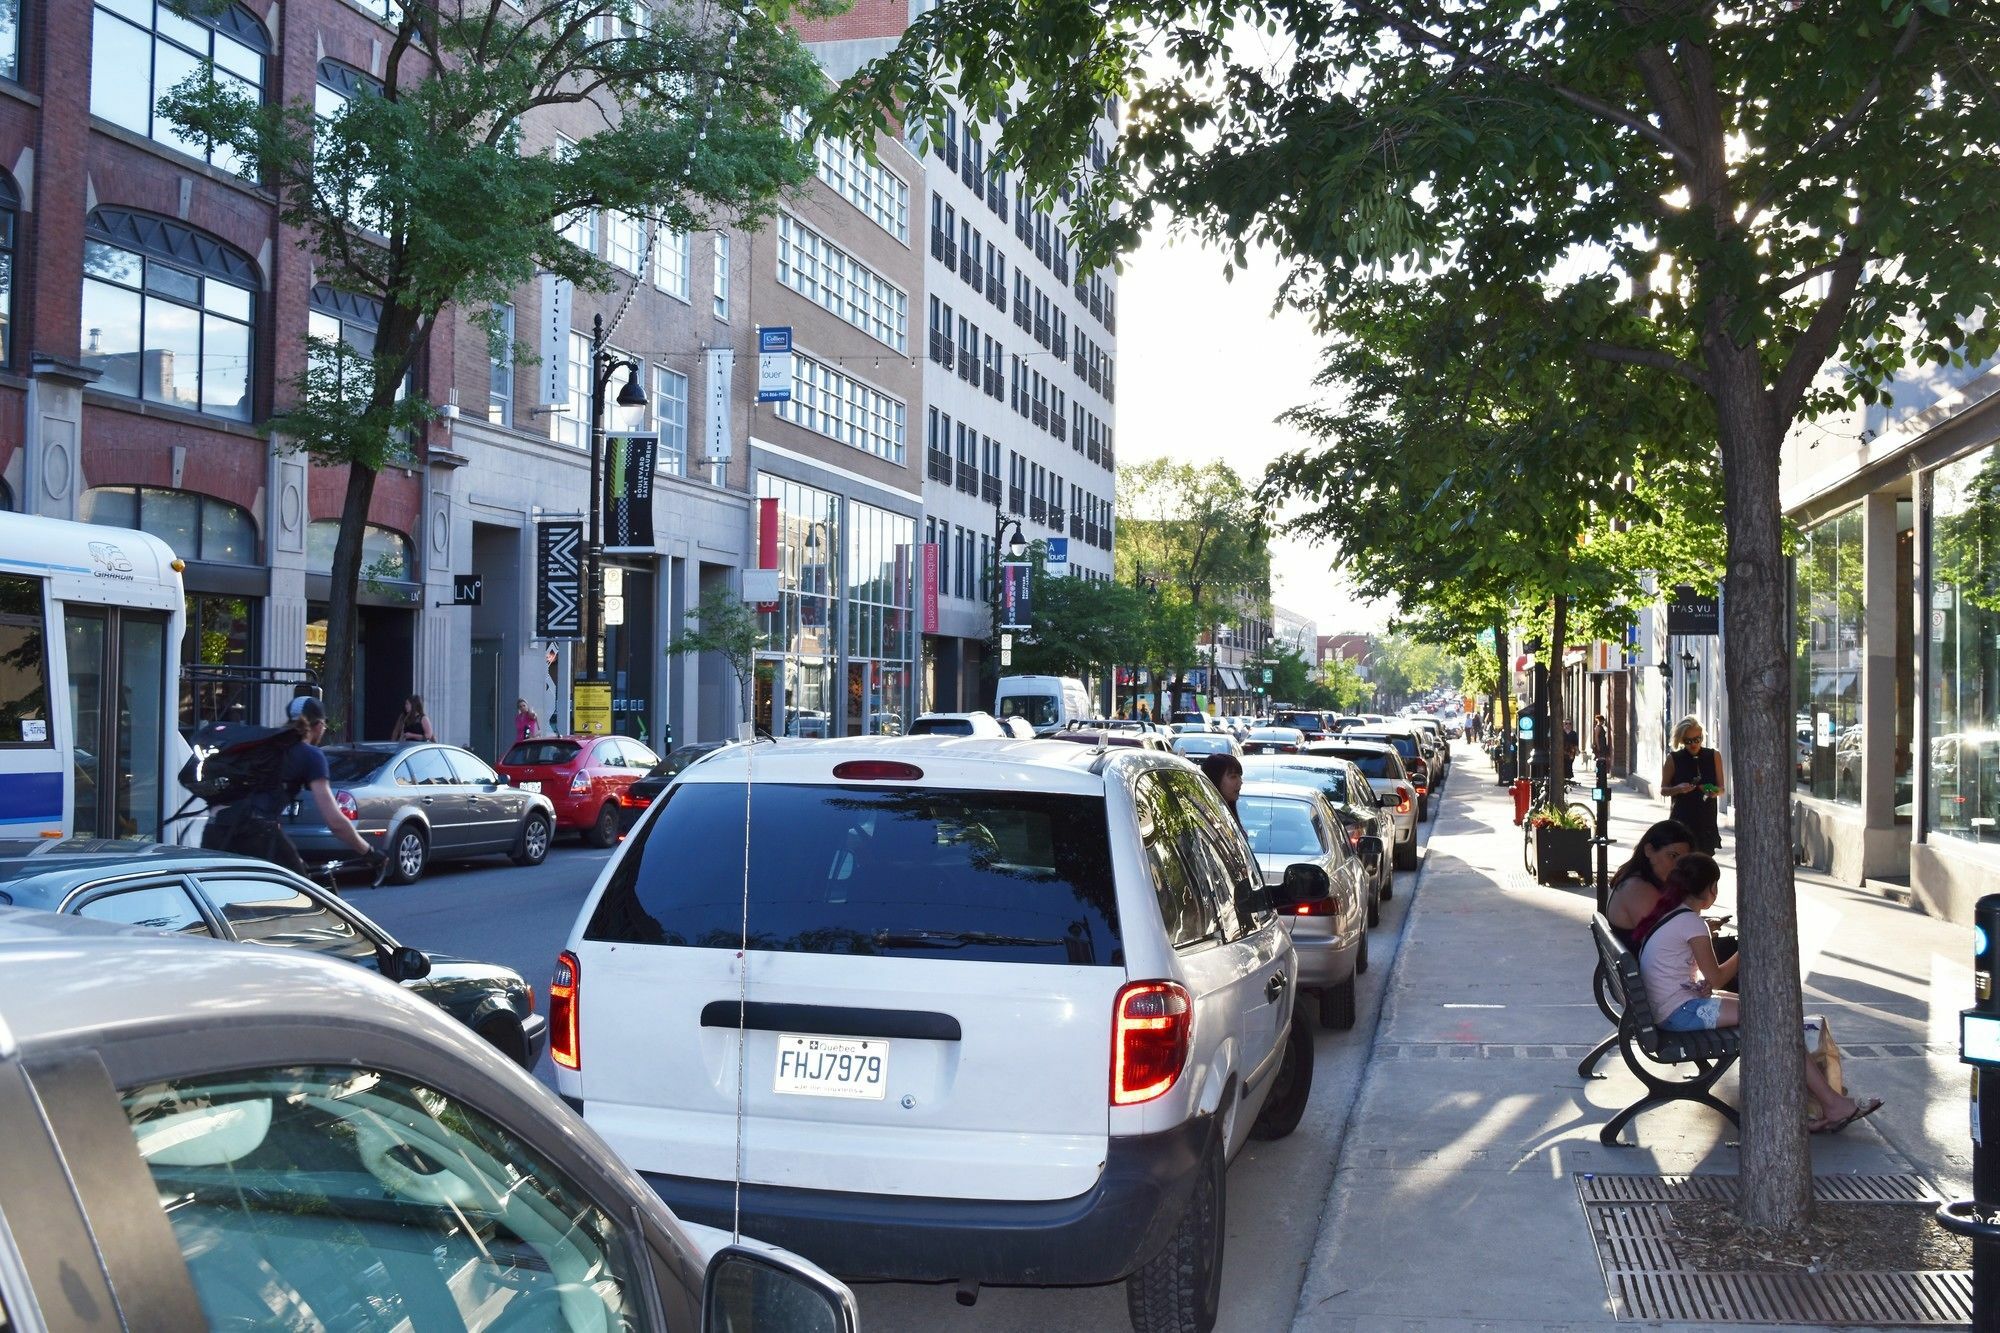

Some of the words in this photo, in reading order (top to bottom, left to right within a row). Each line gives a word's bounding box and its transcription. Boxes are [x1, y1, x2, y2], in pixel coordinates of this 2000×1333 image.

[637, 456, 645, 499] BOULEVARD
[643, 441, 653, 499] SAINT-LAURENT
[928, 545, 936, 582] meubles
[1049, 553, 1066, 561] louer
[928, 594, 936, 629] accents
[1671, 604, 1694, 613] T'AS
[1696, 604, 1711, 613] VU
[780, 1050, 882, 1084] FHJ7979
